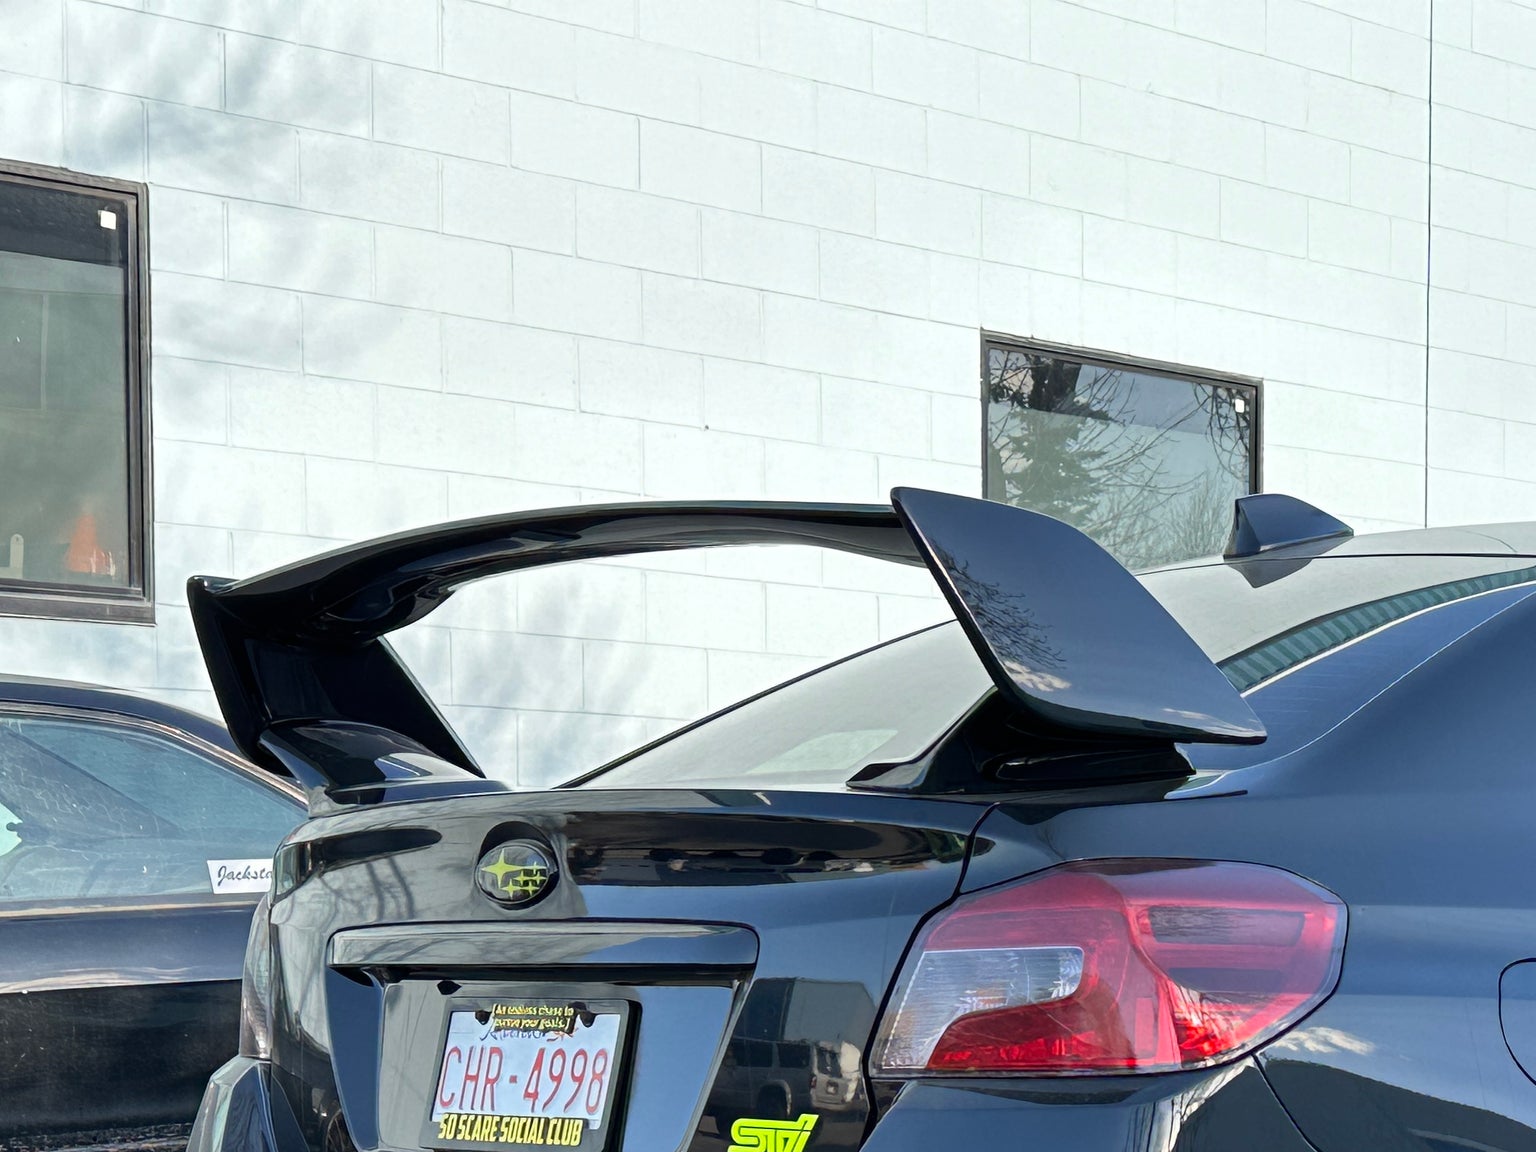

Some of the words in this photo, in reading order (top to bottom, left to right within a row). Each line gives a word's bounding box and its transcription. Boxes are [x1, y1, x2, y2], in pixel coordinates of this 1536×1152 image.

[438, 1114, 457, 1140] SO
[457, 1115, 499, 1142] SCARE
[499, 1117, 545, 1144] SOCIAL
[546, 1119, 583, 1146] CLUB
